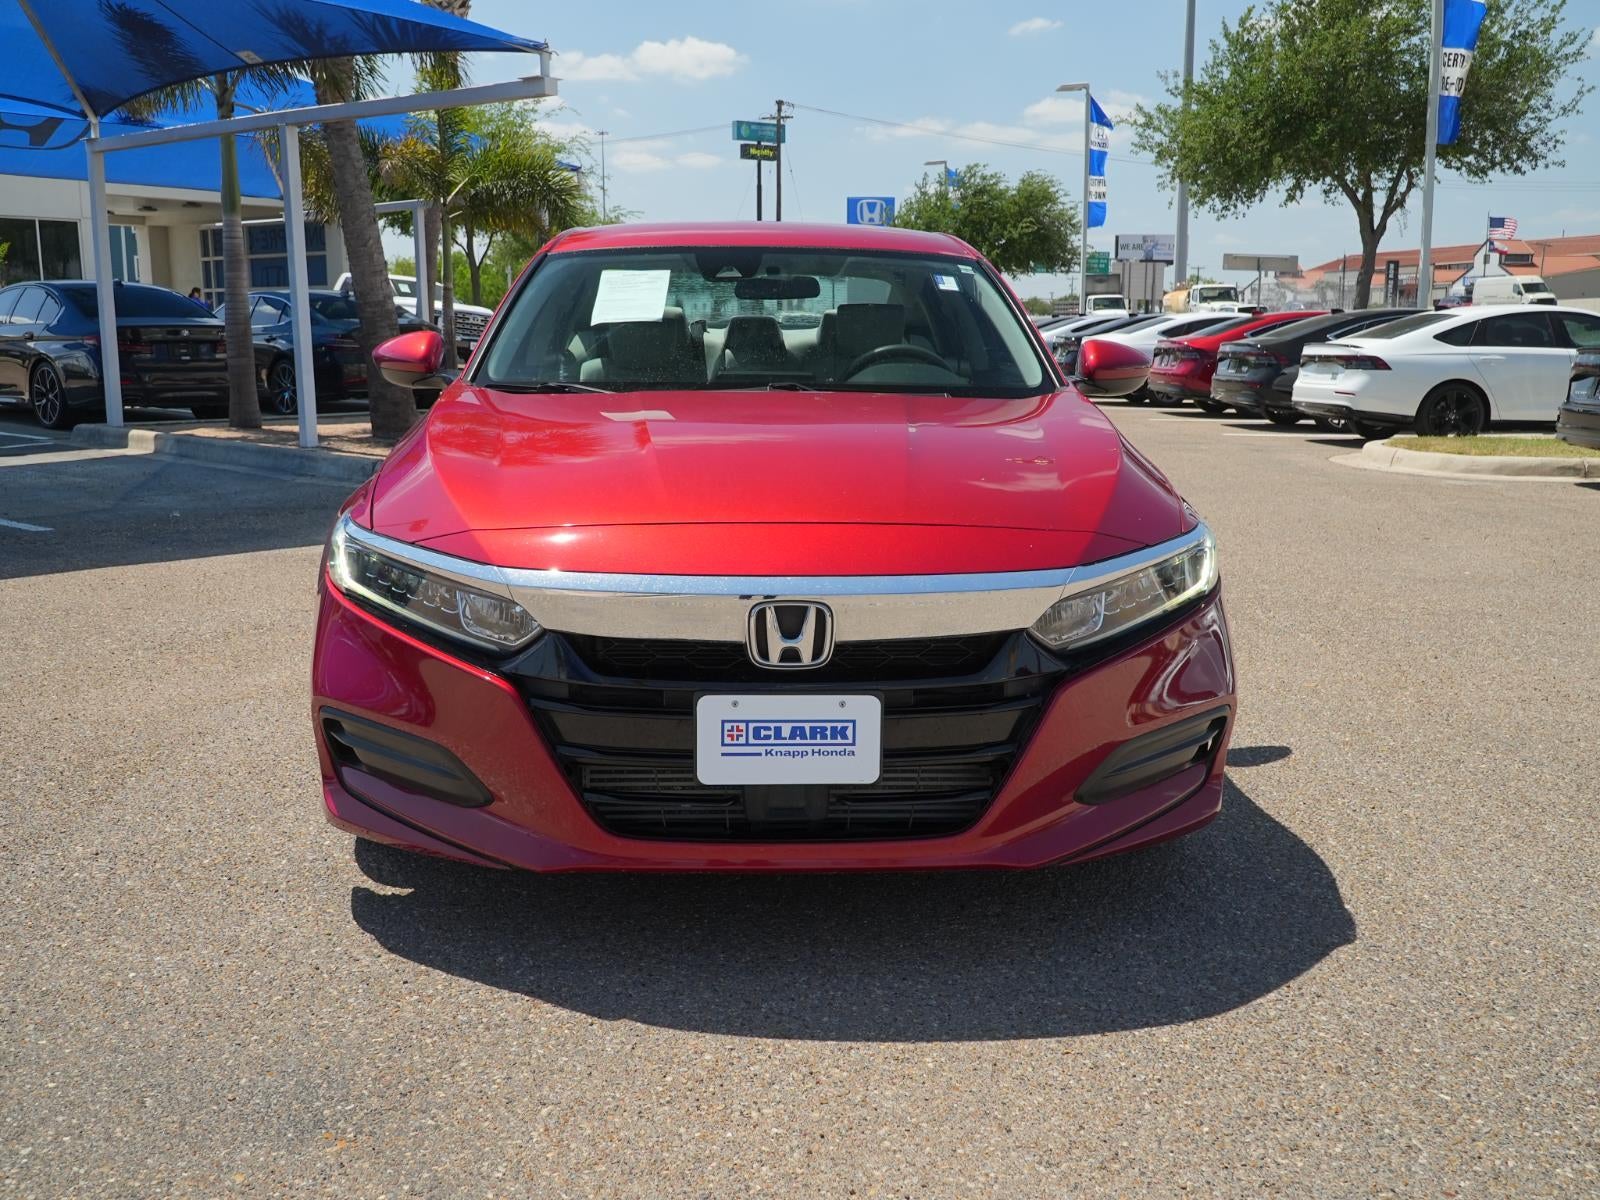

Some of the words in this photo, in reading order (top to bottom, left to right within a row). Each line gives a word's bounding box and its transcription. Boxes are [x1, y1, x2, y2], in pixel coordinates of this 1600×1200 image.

[752, 725, 850, 741] CLARK
[765, 749, 809, 759] Knapp
[811, 748, 856, 757] Honda
